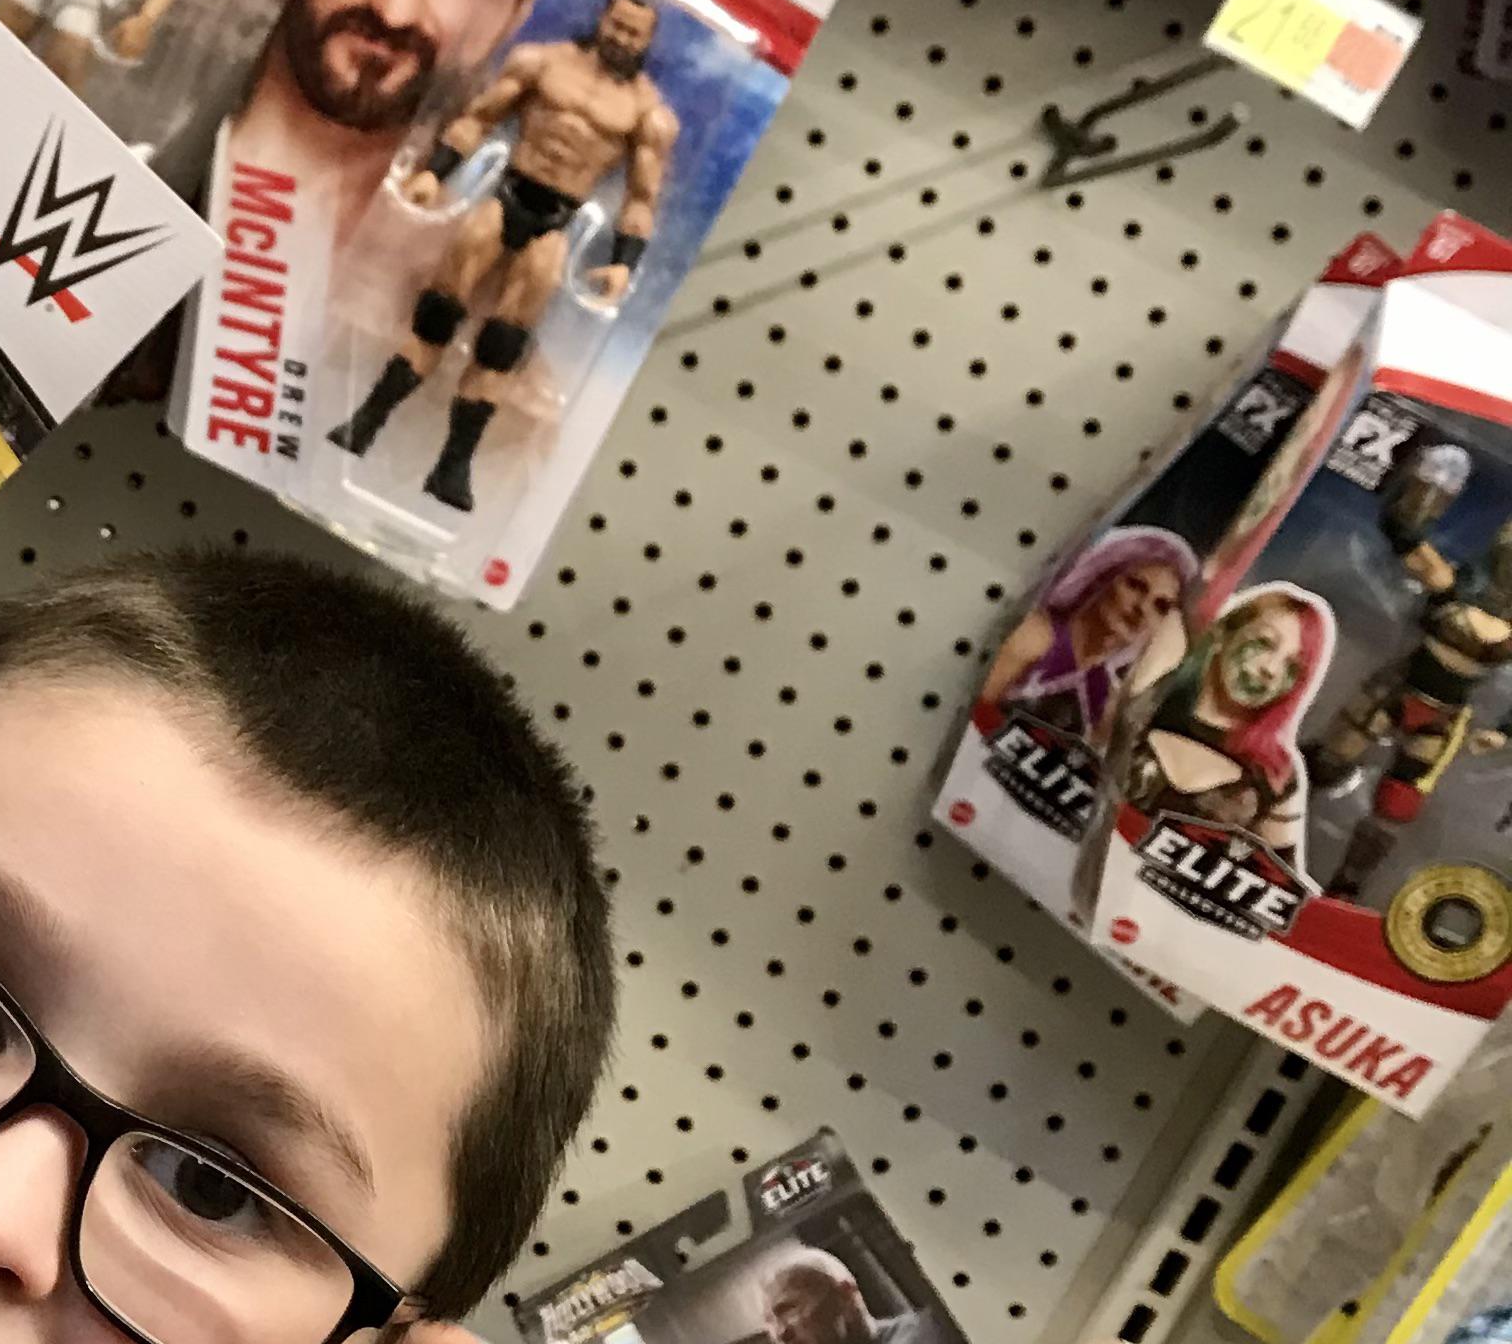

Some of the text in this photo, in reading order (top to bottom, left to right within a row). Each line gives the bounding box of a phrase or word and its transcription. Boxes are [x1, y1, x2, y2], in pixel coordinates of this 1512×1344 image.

[207, 161, 297, 456] McINTYRE
[273, 358, 309, 462] DREW
[994, 726, 1095, 823] ELIT
[1143, 827, 1302, 926] ELITE
[1243, 983, 1435, 1102] ASUKA
